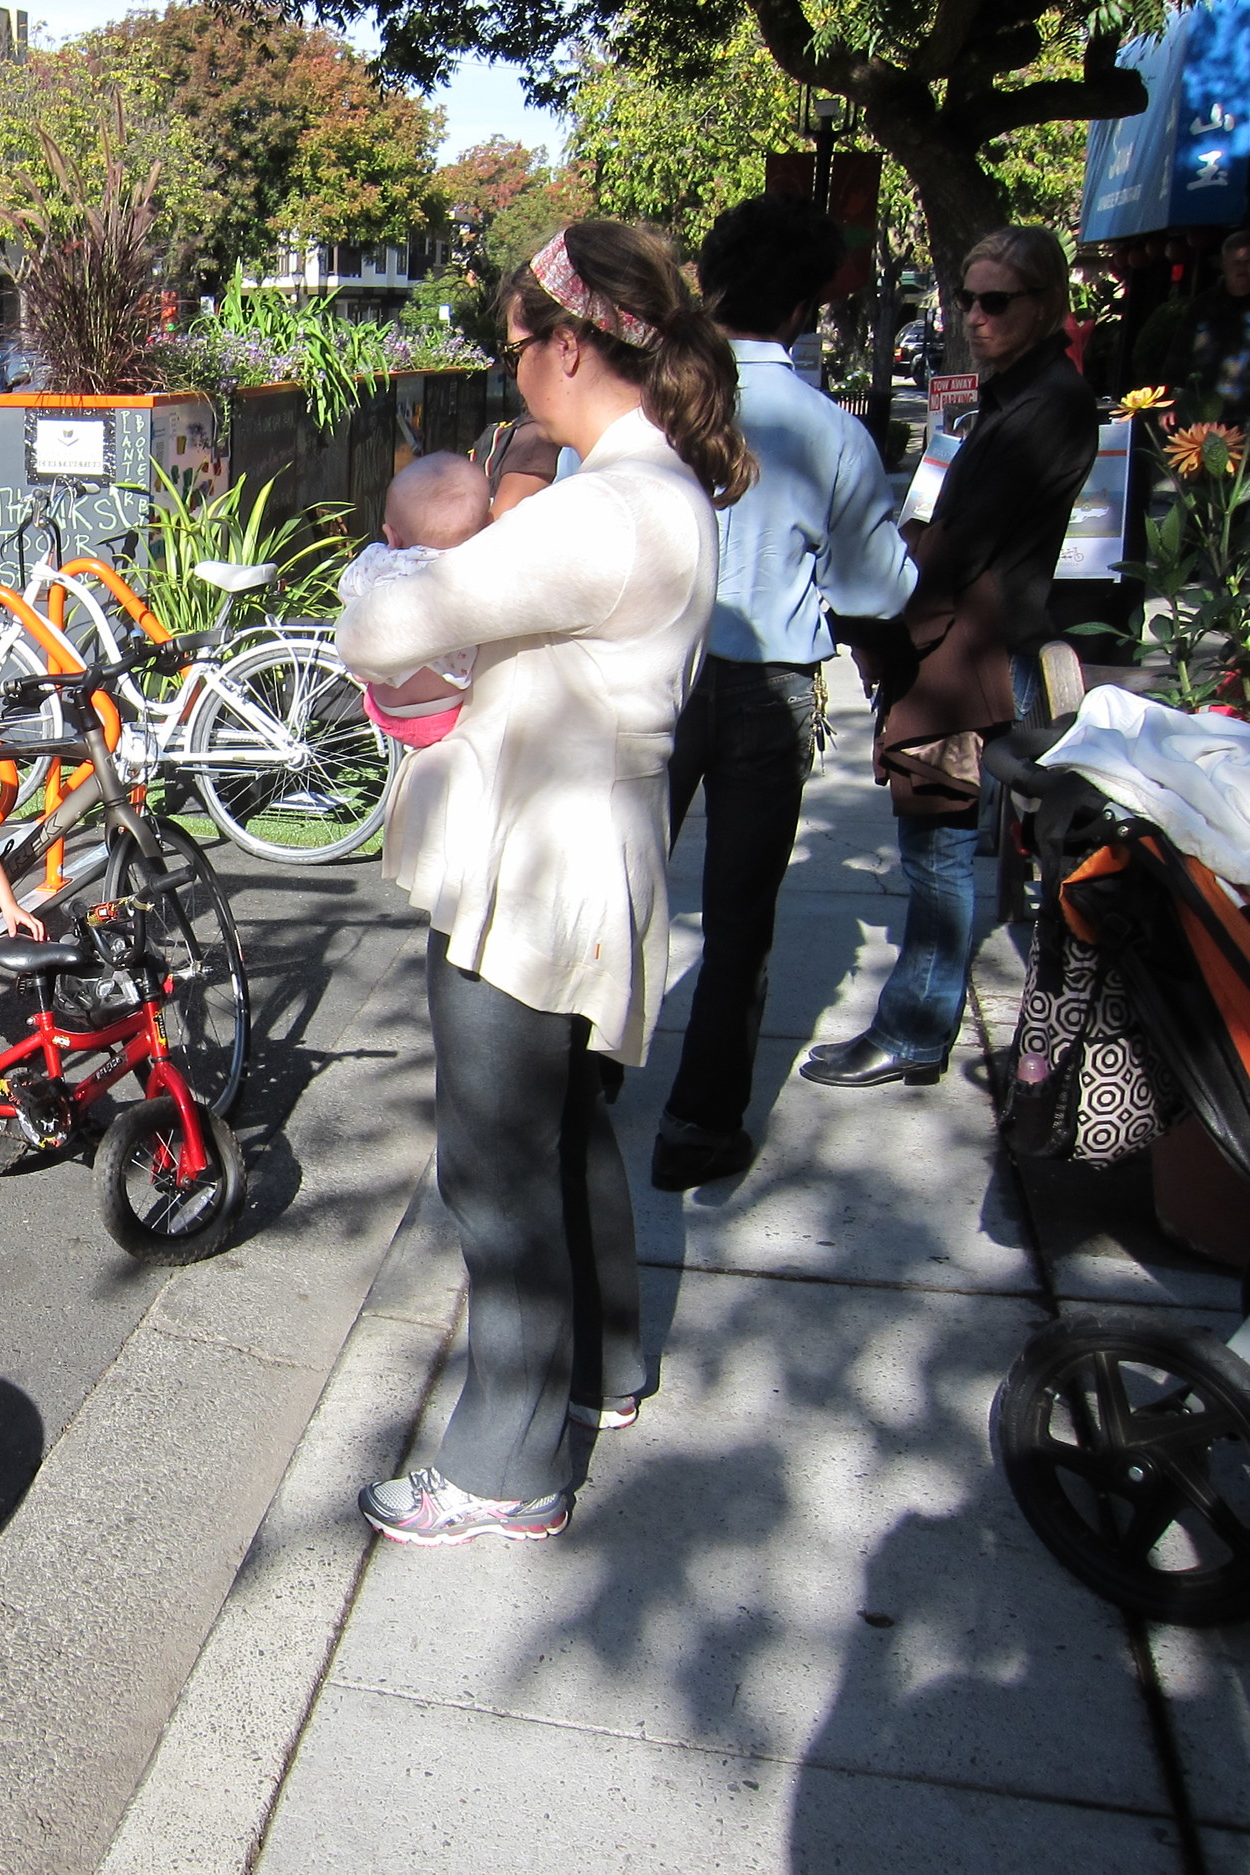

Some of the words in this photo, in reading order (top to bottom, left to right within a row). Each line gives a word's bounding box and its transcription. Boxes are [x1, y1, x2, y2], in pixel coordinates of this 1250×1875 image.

[931, 394, 940, 410] NO
[933, 380, 949, 391] TOW
[950, 378, 973, 390] AWAY
[120, 410, 135, 507] PLANTR
[7, 812, 64, 874] REK
